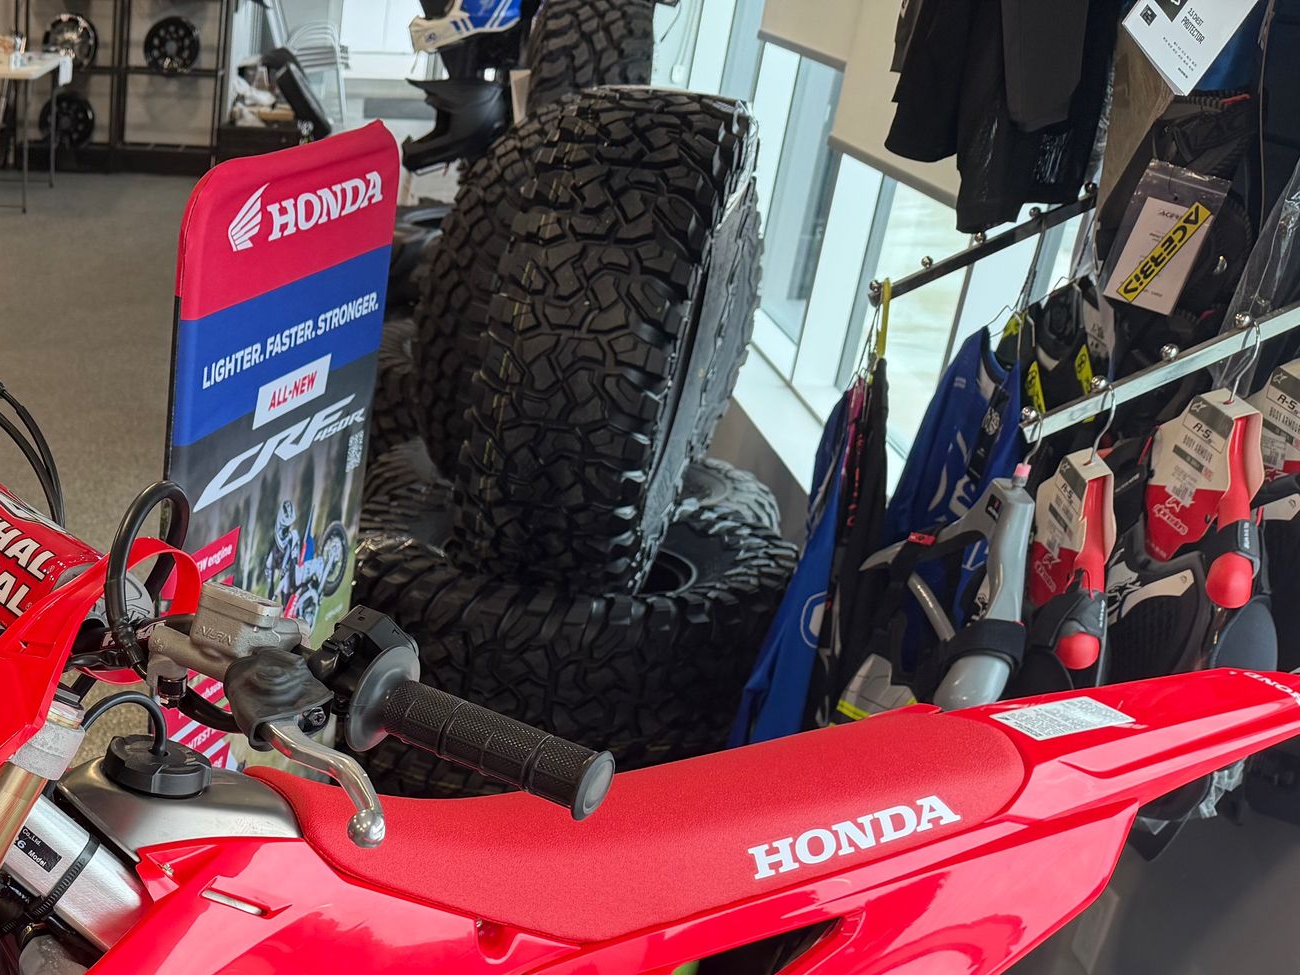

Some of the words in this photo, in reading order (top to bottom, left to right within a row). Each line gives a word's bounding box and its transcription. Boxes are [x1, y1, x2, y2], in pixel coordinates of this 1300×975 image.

[1180, 16, 1206, 45] PROTECTOR
[266, 170, 383, 242] HONDA
[1123, 204, 1200, 295] ACERBIS
[202, 343, 265, 390] LIGHTER.
[265, 319, 316, 360] FASTER.
[316, 291, 379, 337] STRONGER.
[268, 370, 318, 412] ALL-NEW
[193, 393, 356, 513] CRF
[27, 849, 47, 868] Model
[748, 795, 961, 881] HONDA
